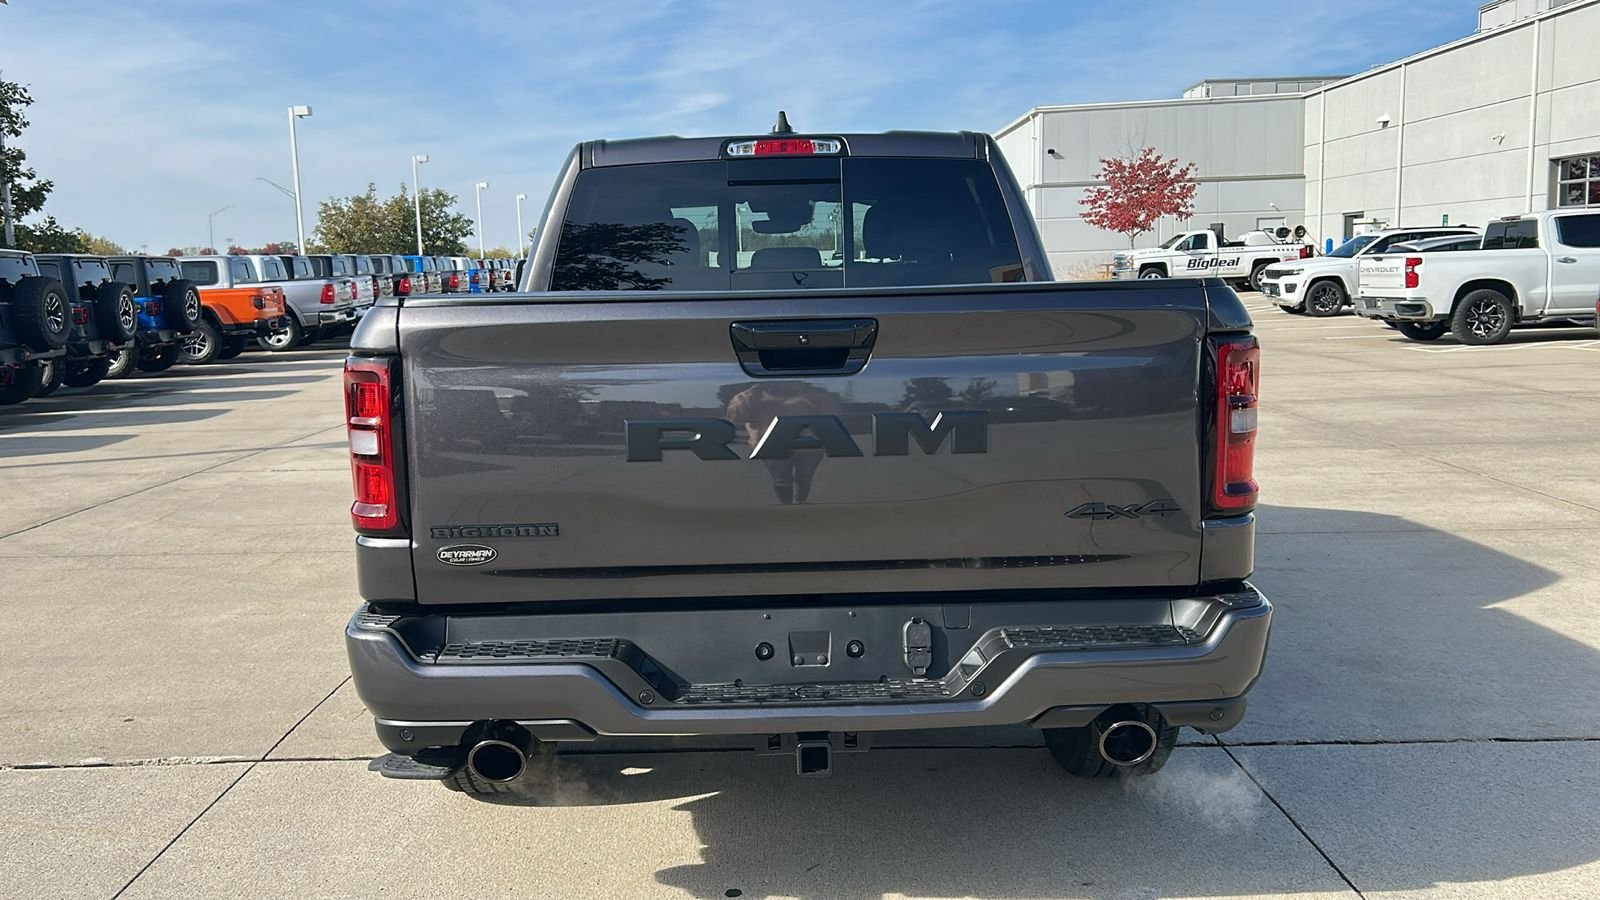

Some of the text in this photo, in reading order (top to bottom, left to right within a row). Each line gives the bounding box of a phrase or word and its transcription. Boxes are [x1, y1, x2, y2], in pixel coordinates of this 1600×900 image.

[1187, 257, 1241, 270] BigDeal
[624, 411, 990, 462] RAM
[431, 523, 559, 538] BIGHORN
[440, 550, 493, 559] DEYARMAN
